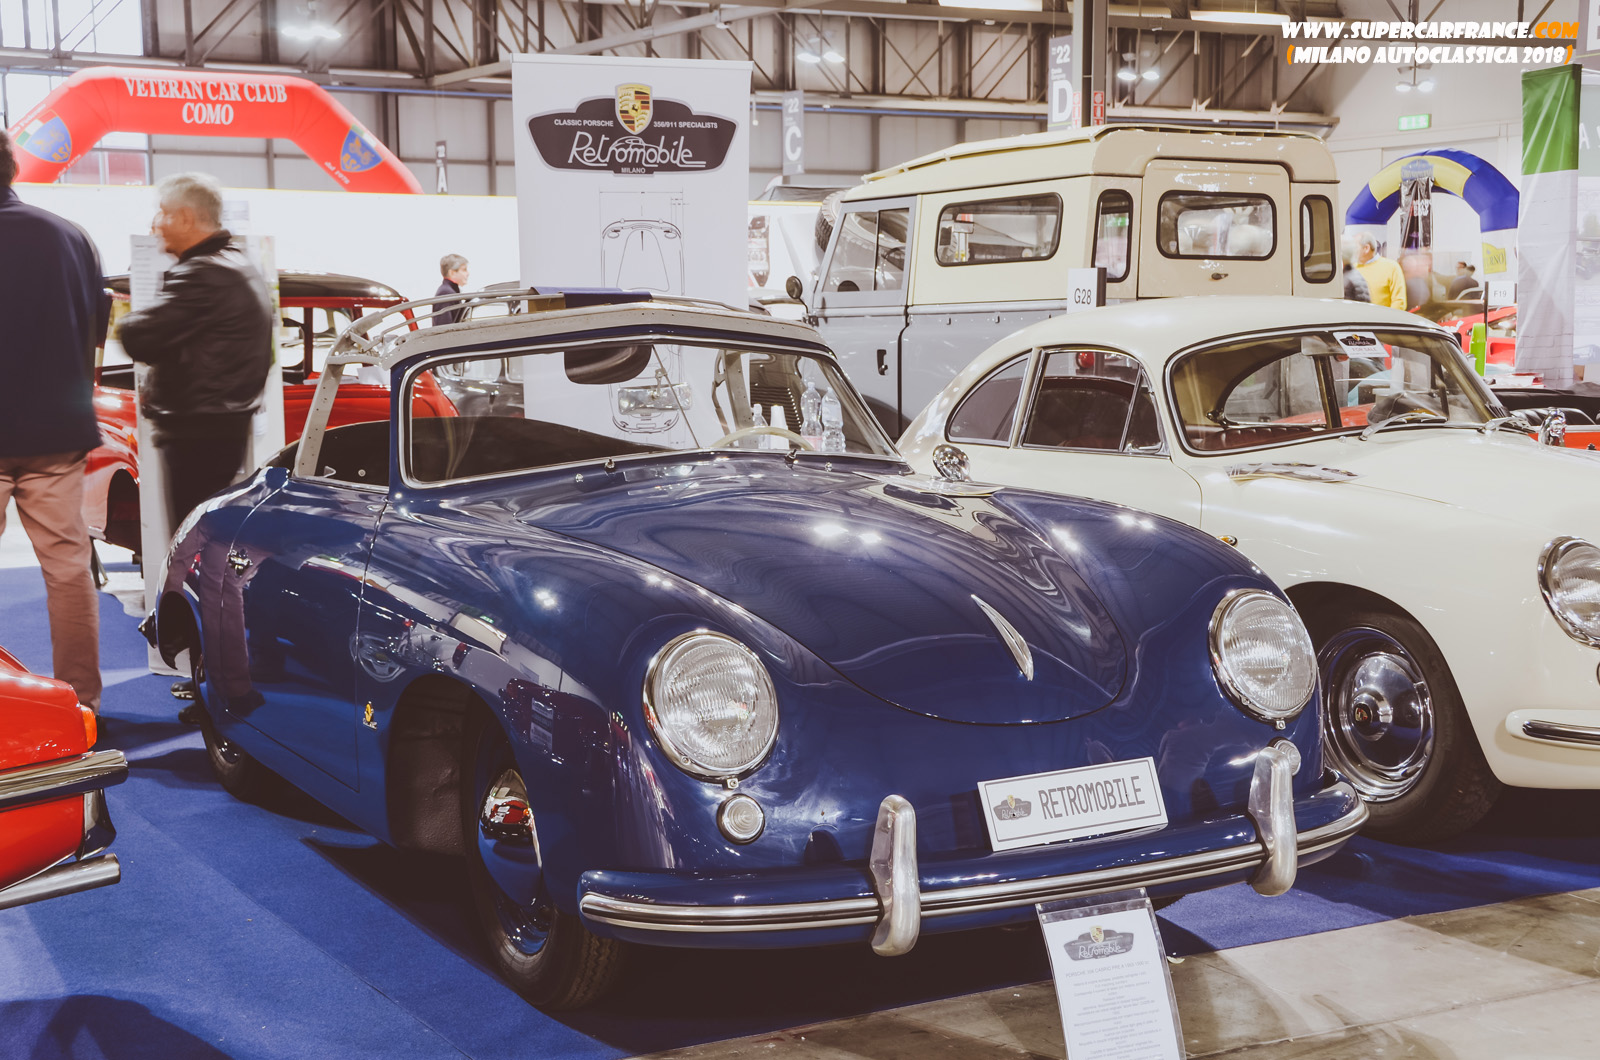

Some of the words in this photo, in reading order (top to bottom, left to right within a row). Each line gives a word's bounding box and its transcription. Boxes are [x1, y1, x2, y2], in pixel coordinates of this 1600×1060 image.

[1056, 44, 1071, 64] 22
[123, 77, 204, 100] VETERAN
[206, 81, 242, 102] CAR
[243, 83, 288, 103] CLUB
[788, 97, 799, 114] 22
[1052, 80, 1073, 122] D
[182, 102, 234, 125] COMO
[553, 118, 582, 127] CLASSIC
[583, 119, 614, 127] PORSCHE
[678, 121, 718, 129] SPECIALISTS
[567, 131, 706, 168] Retromobile
[785, 126, 802, 161] C
[1074, 288, 1093, 305] G28
[1493, 290, 1507, 298] F19
[1038, 775, 1145, 820] RETROMOBILE
